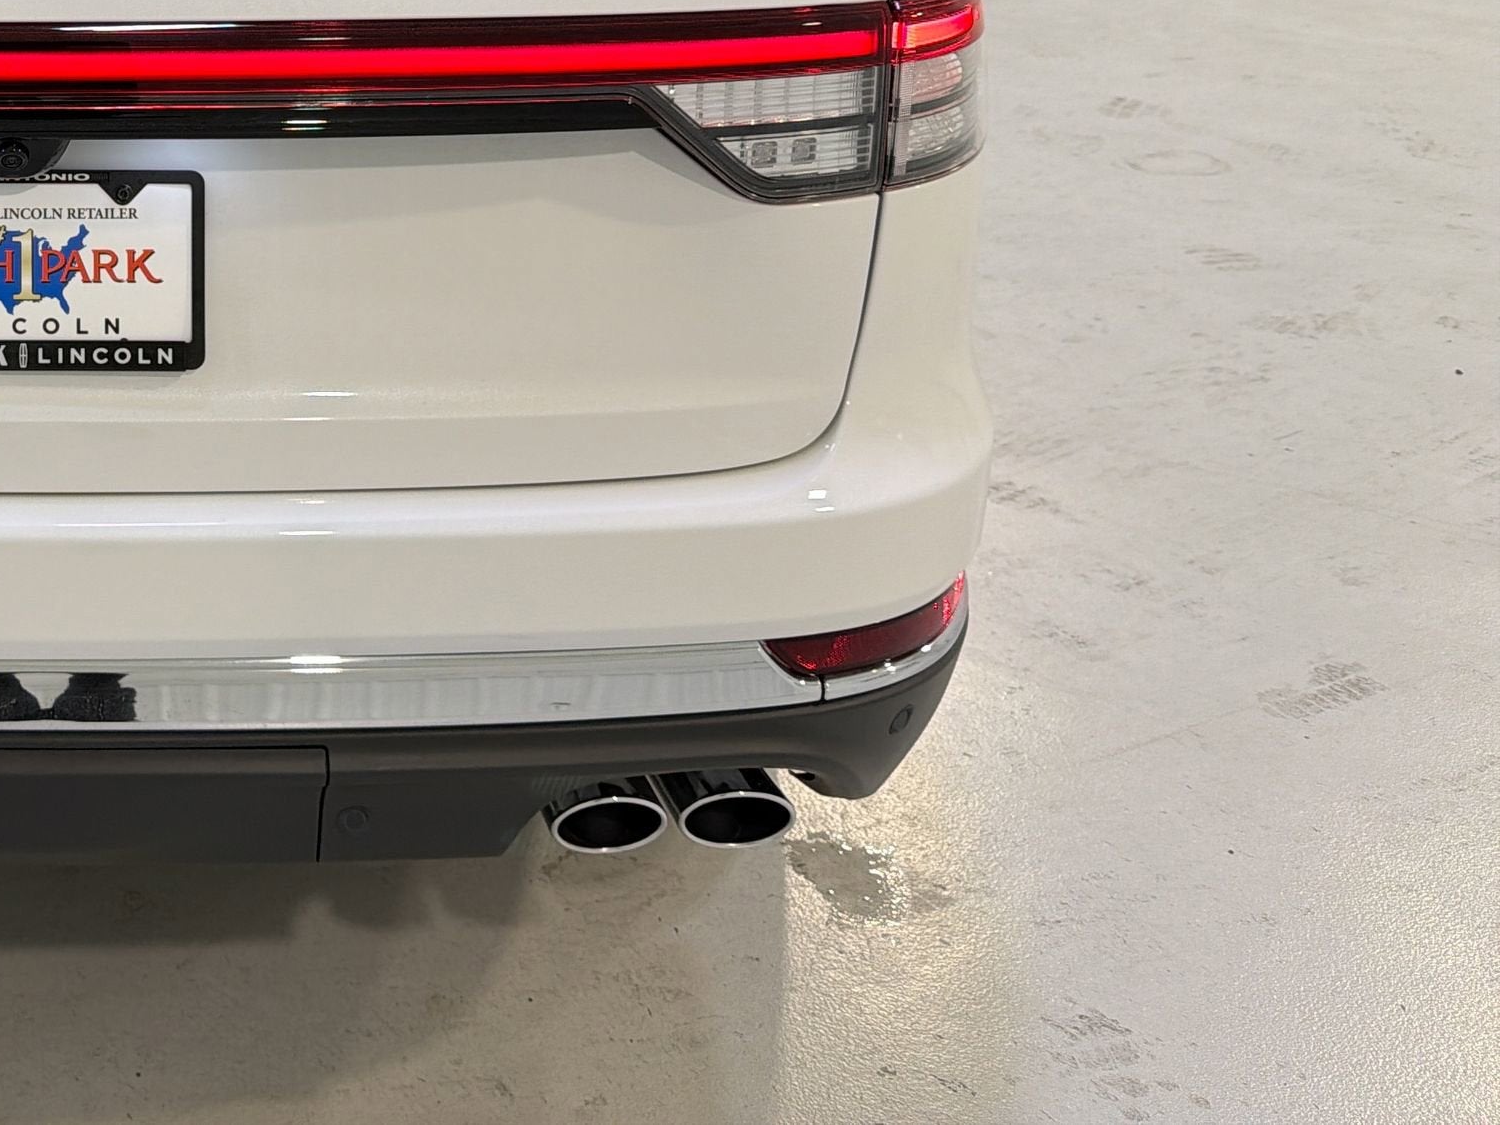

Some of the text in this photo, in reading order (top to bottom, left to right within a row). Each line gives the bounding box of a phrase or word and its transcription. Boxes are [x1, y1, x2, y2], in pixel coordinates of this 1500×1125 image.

[67, 208, 139, 220] RETAILER
[41, 249, 164, 284] PARK
[37, 347, 174, 365] LINCOLN
